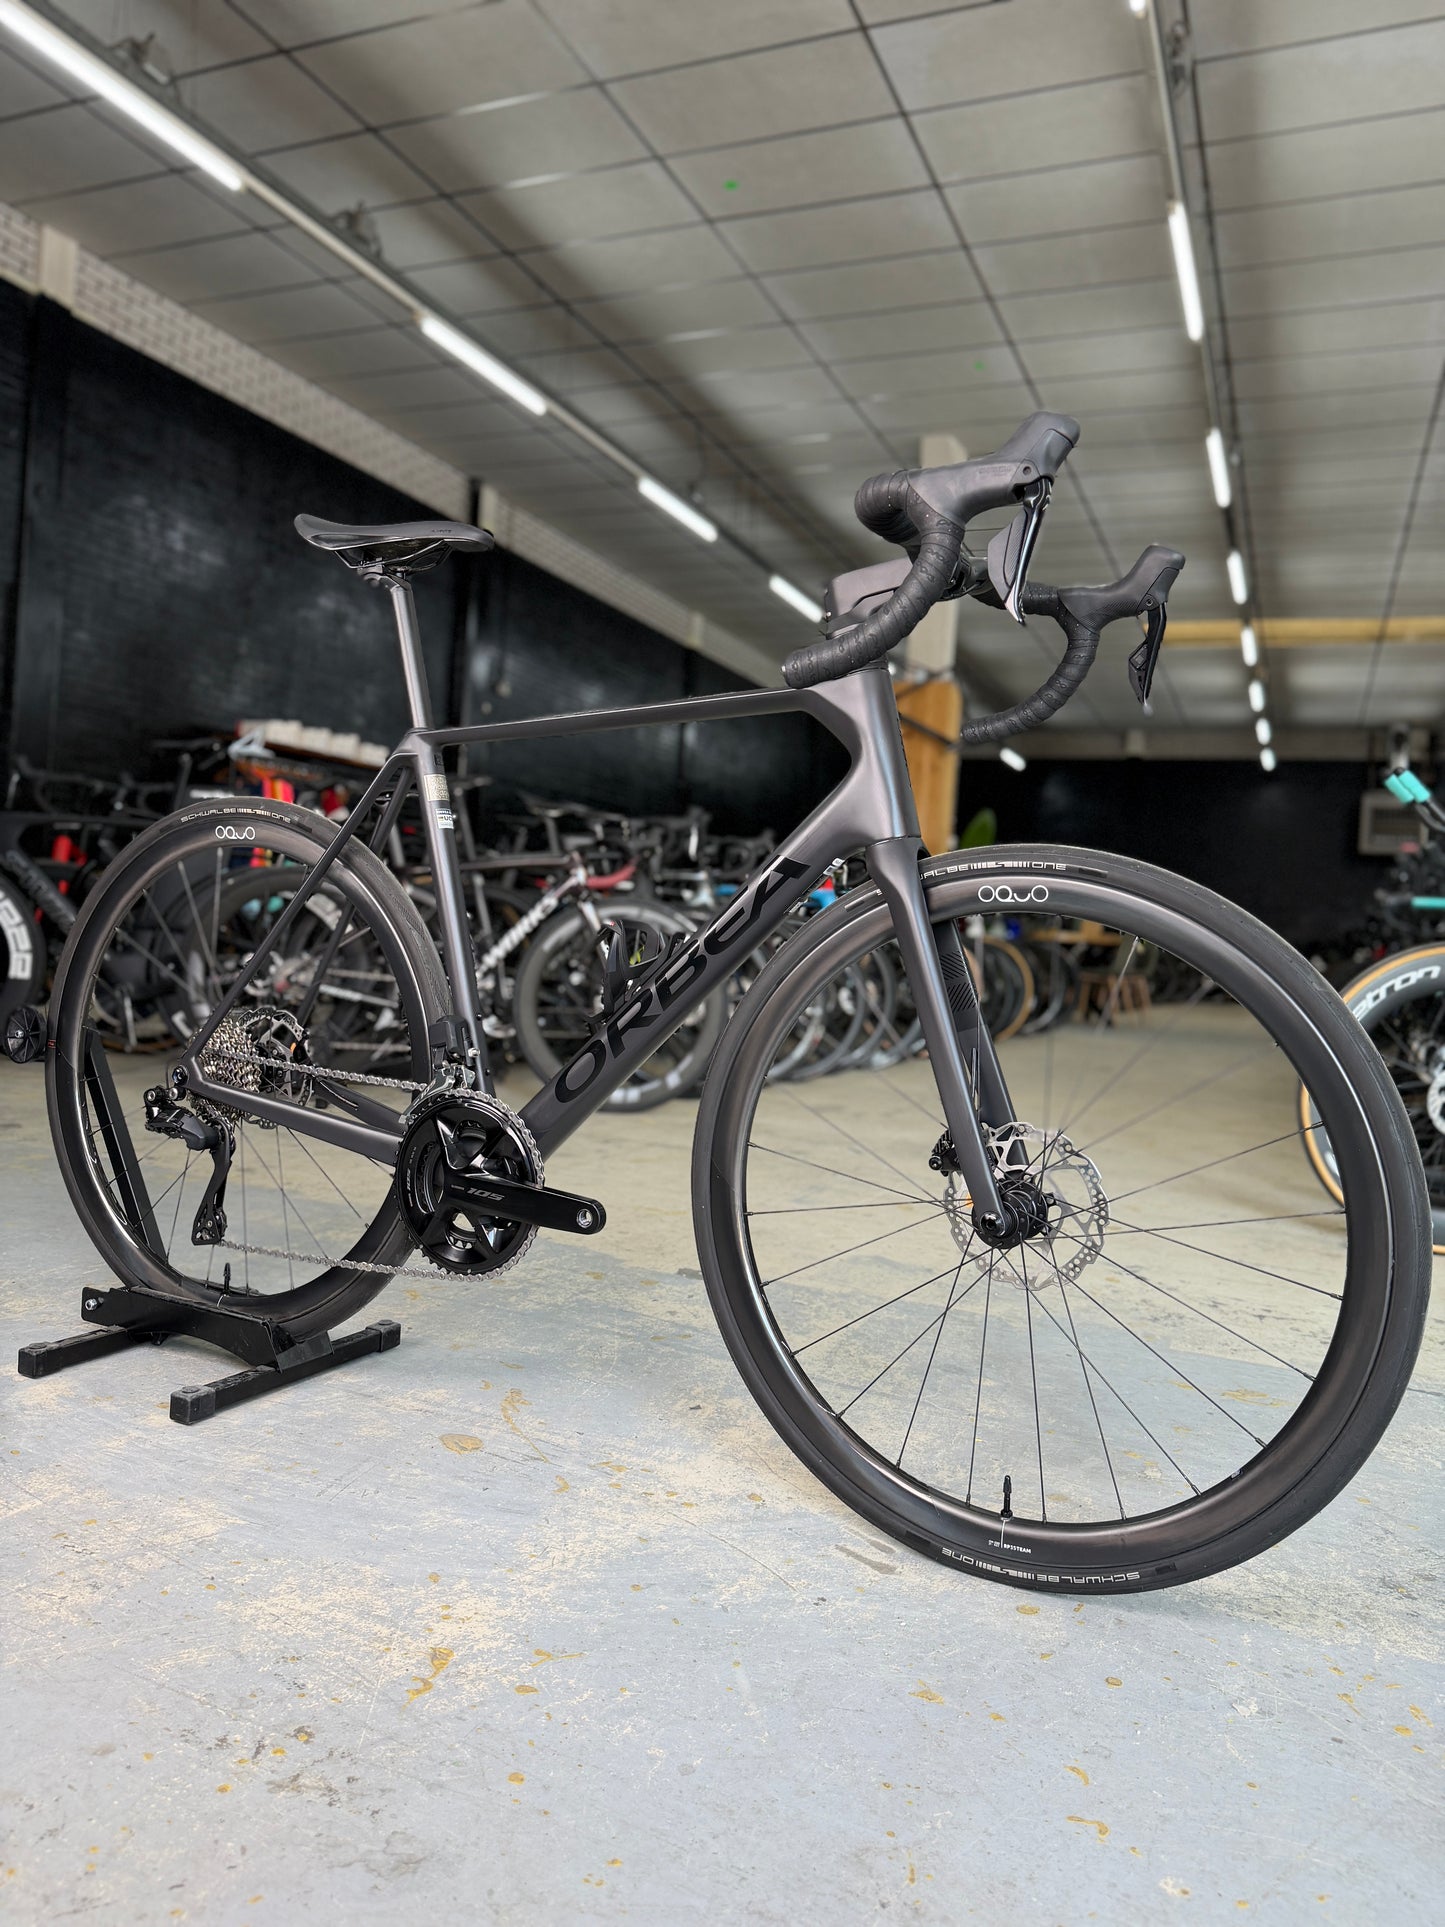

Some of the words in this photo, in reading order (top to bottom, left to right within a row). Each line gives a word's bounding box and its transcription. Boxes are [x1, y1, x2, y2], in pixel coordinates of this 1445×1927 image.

[180, 807, 237, 823] SCHWALBE
[271, 812, 291, 823] ONE
[1031, 862, 1067, 871] ONE
[554, 854, 812, 1104] ORBEA
[466, 1187, 506, 1202] 105
[941, 1547, 974, 1565] ONE
[1036, 1570, 1141, 1584] SCHWALBE
